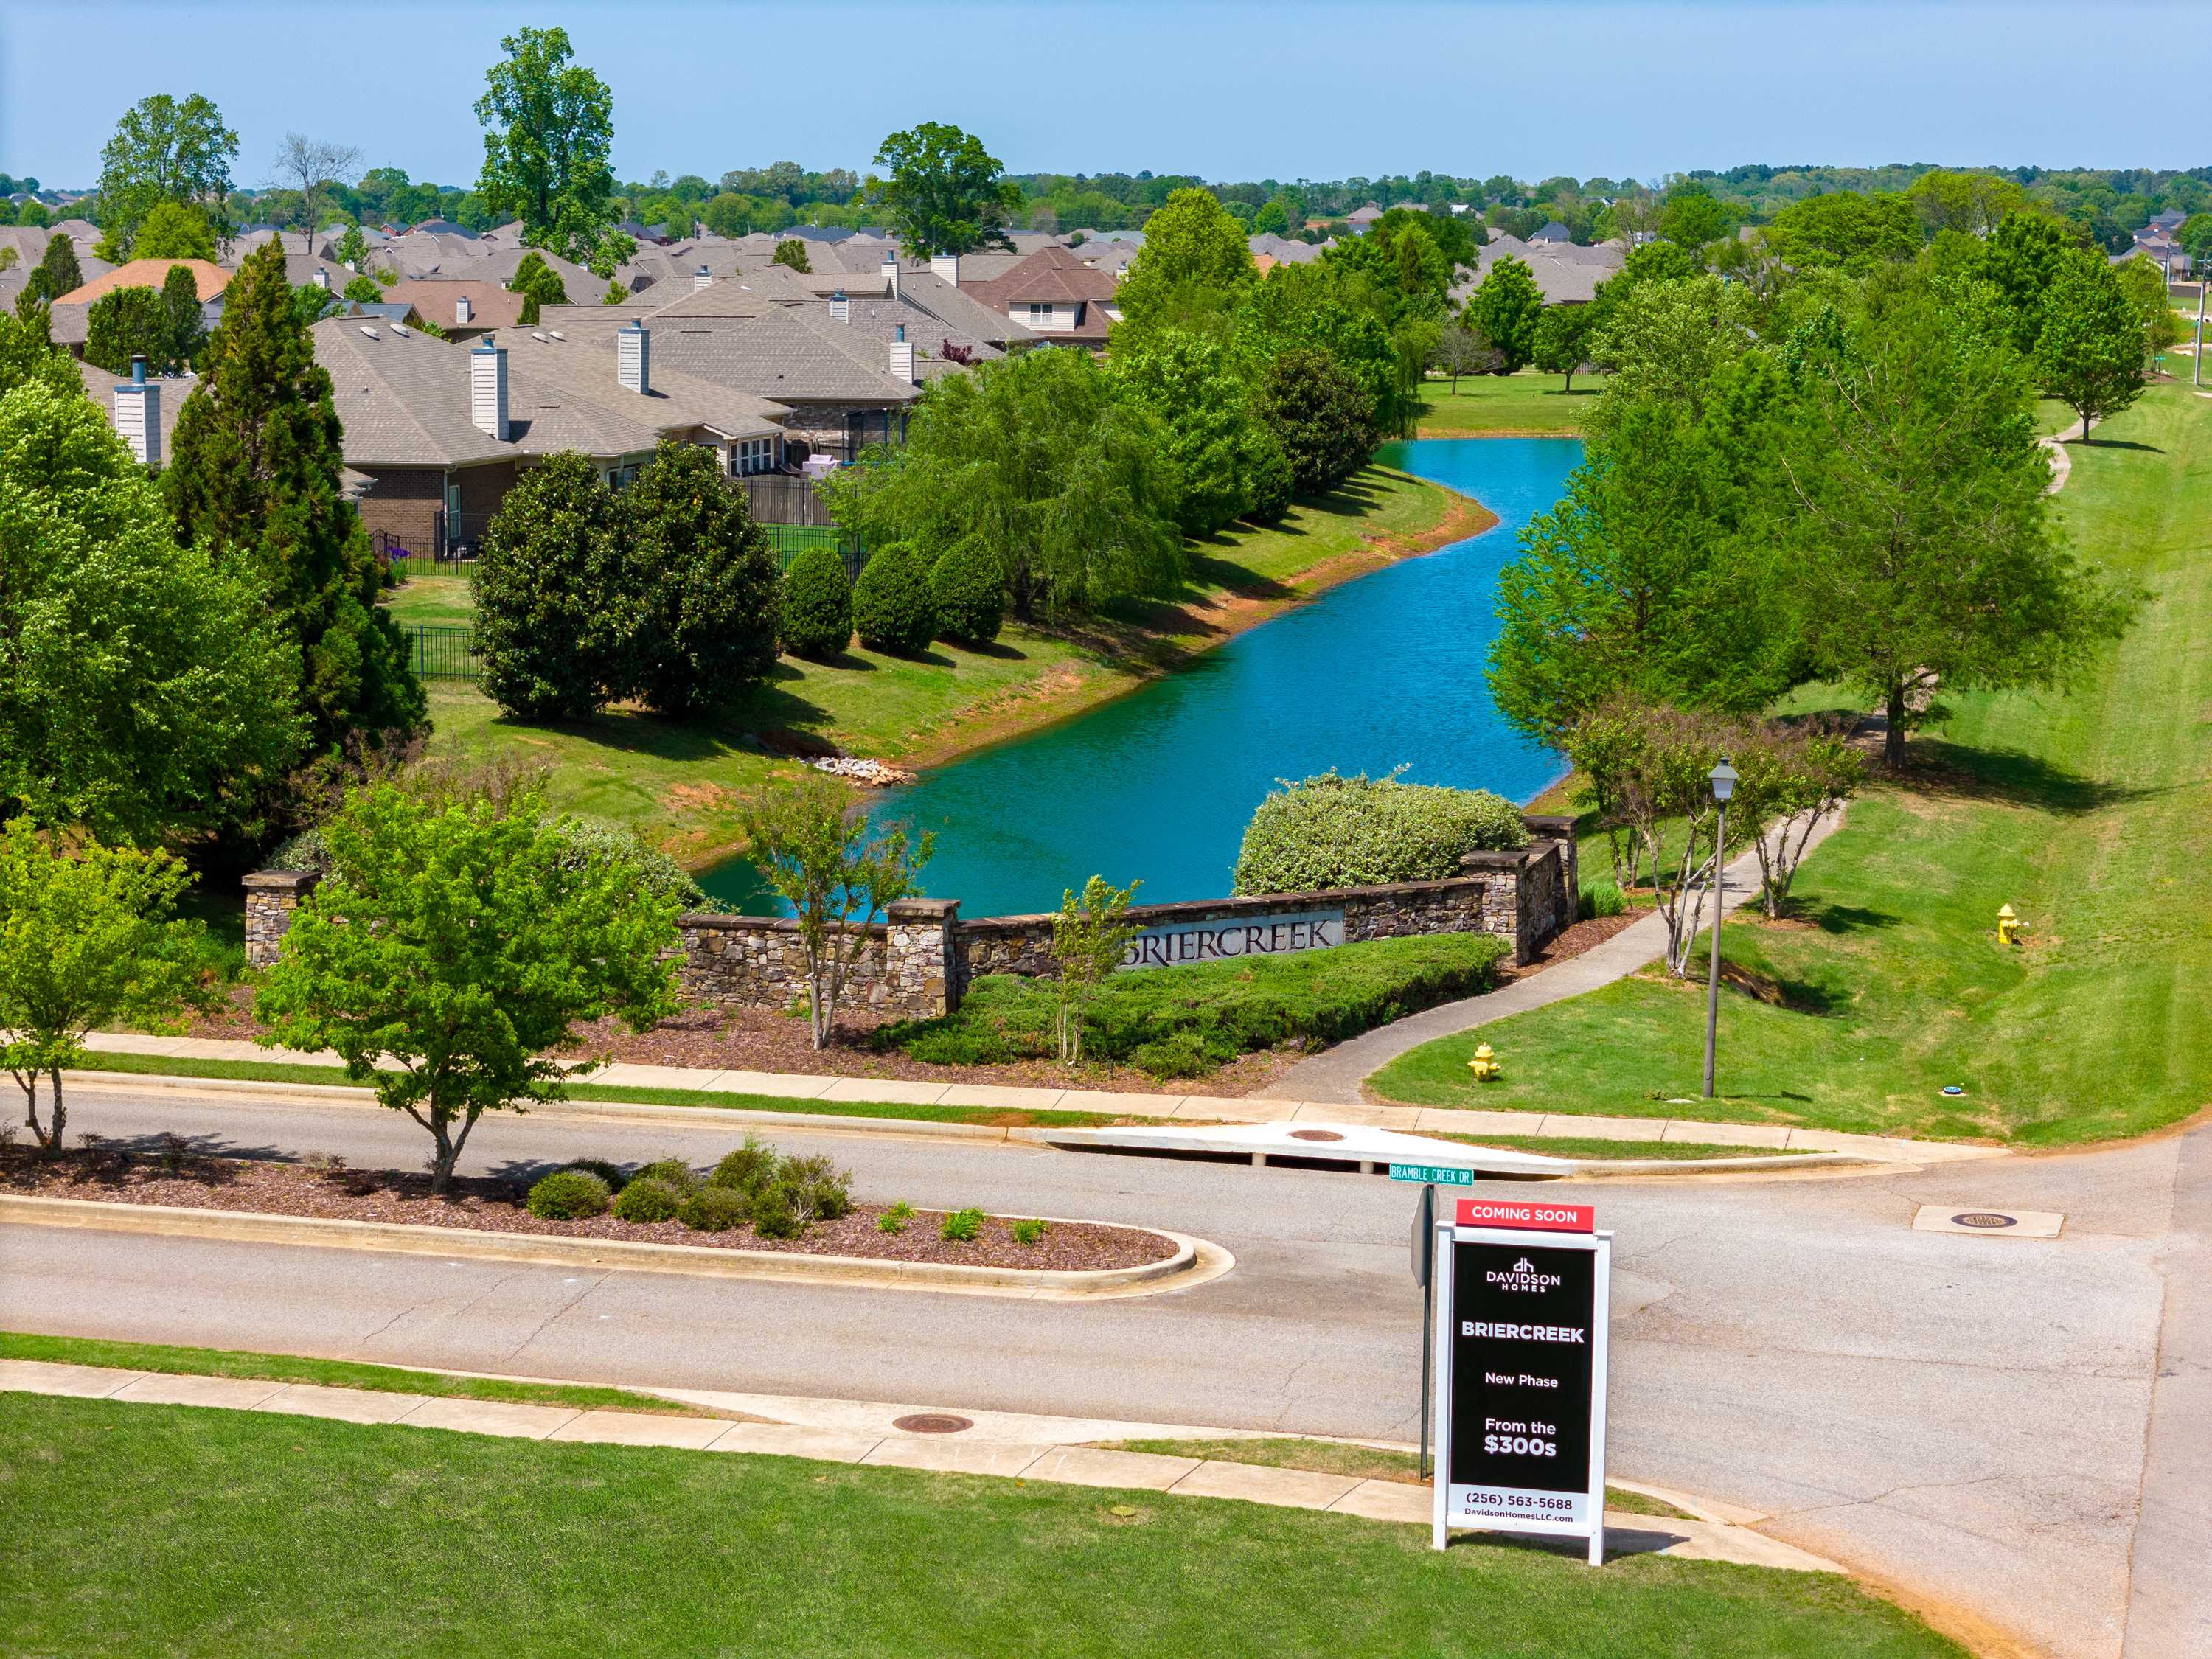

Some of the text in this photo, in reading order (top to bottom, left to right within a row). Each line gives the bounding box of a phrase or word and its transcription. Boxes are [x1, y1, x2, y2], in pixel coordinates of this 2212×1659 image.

[1391, 1165, 1427, 1180] BRAMBLE
[1431, 1169, 1456, 1183] CREEK
[1472, 1206, 1577, 1223] COMING SOON
[1486, 1271, 1561, 1286] DAVIDSON
[1502, 1283, 1546, 1293] HOMES
[1462, 1321, 1585, 1343] BRIERCREEK
[1486, 1372, 1558, 1388] New Phase
[1486, 1418, 1557, 1435] From the
[1484, 1435, 1557, 1457] $300s
[1466, 1492, 1573, 1509] (256) 563-5688
[1464, 1508, 1573, 1523] DavidsonHomesLLC.com
